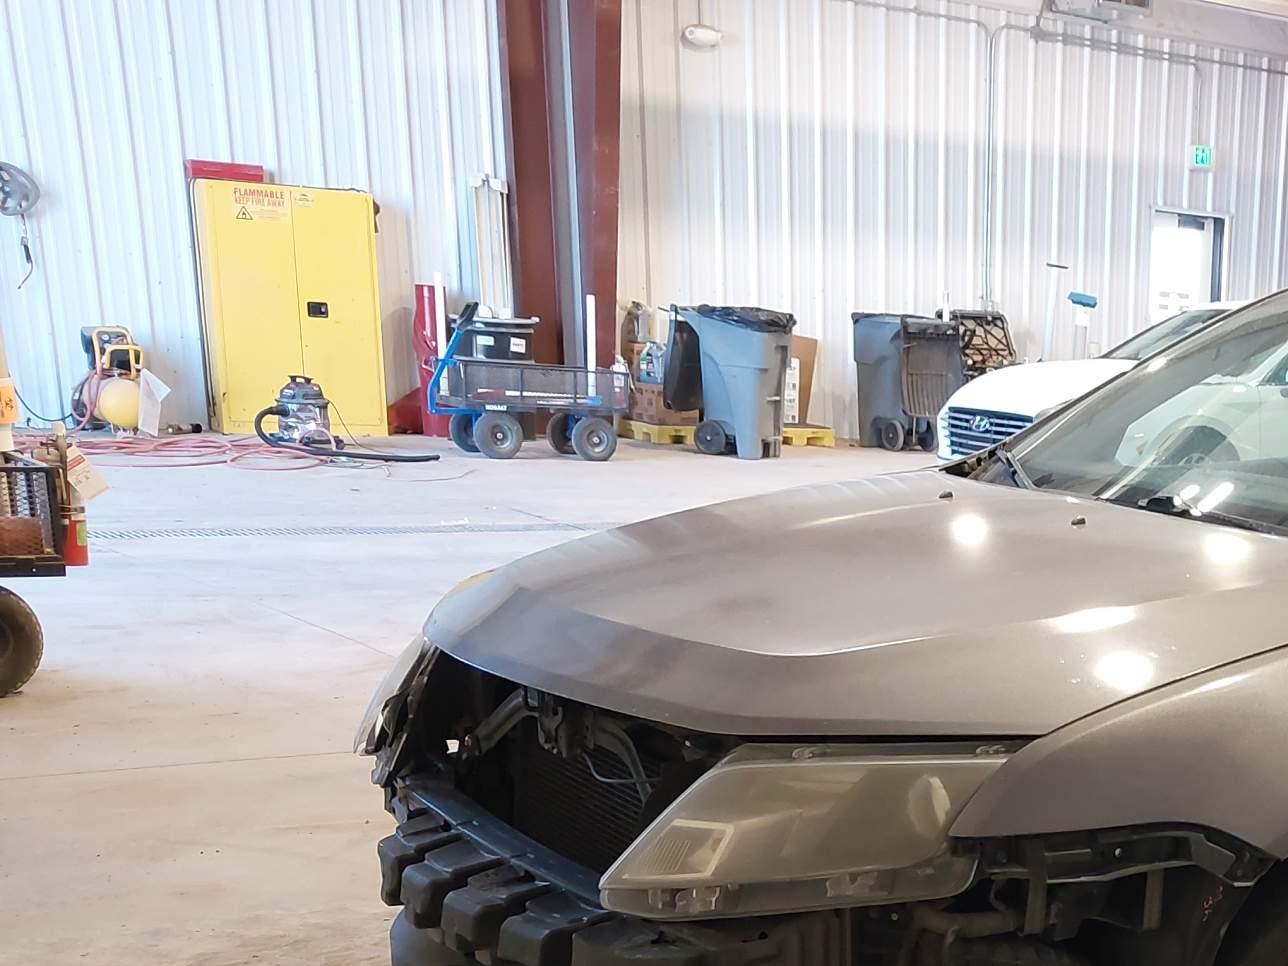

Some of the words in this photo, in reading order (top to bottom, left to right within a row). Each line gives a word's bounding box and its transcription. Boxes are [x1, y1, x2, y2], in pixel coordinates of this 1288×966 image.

[233, 187, 285, 200] FLAMMABLE
[234, 196, 249, 205] KEEP
[266, 198, 285, 208] AWAY
